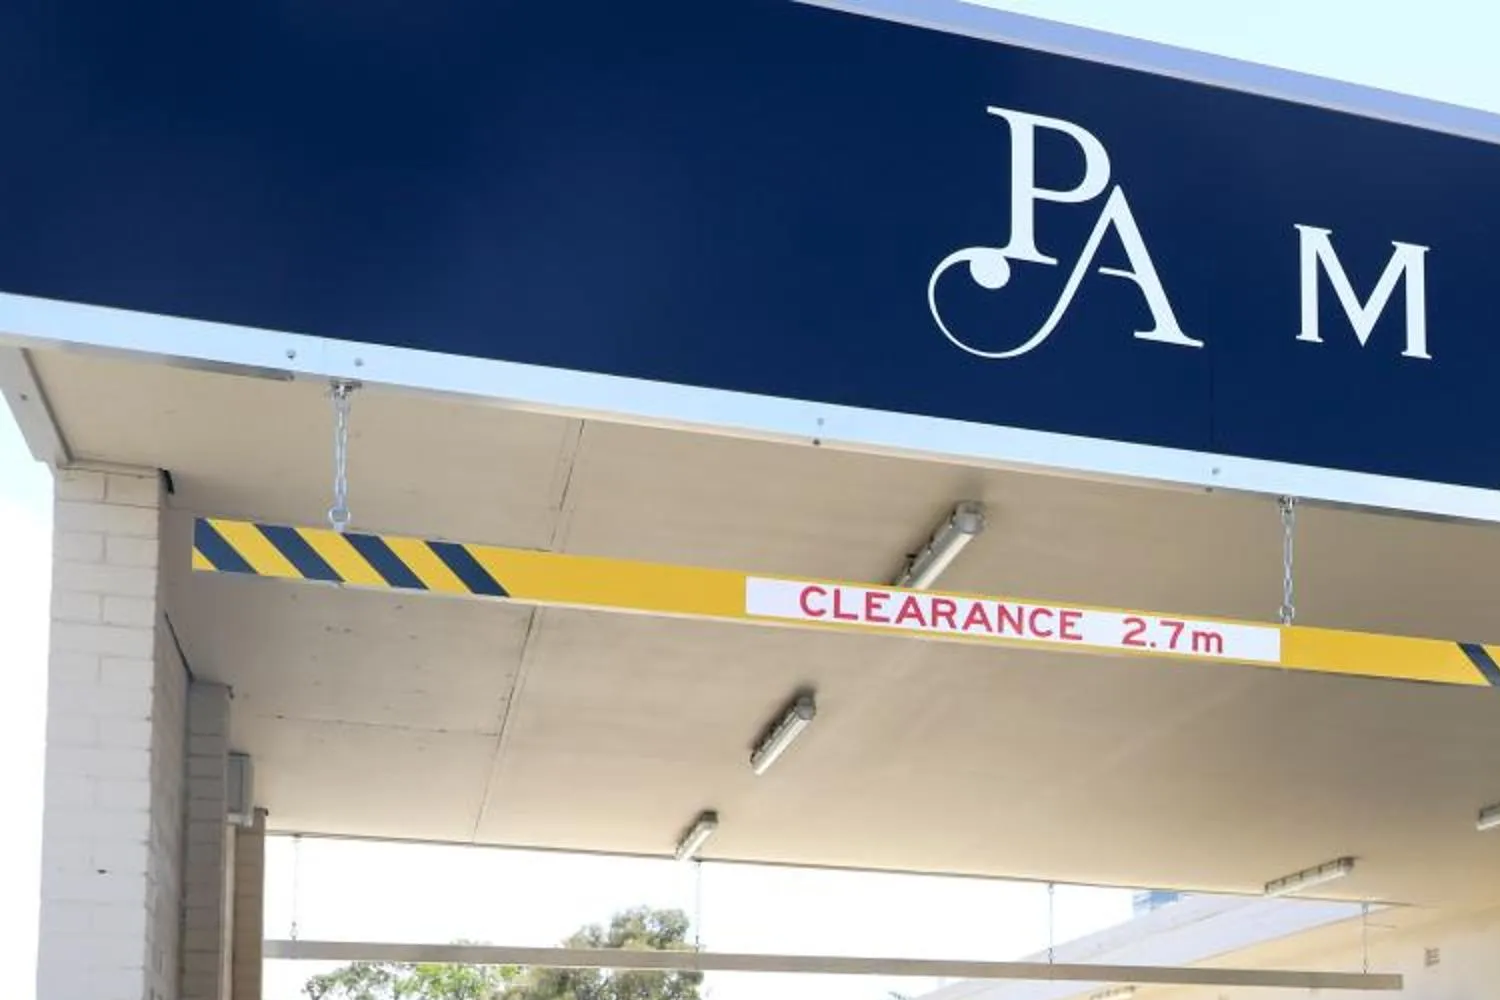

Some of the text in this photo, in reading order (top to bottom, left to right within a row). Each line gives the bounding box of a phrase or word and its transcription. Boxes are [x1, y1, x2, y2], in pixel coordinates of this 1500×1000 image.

[927, 105, 1204, 358] PA
[799, 585, 1224, 654] CLEARANCE 2.7m
